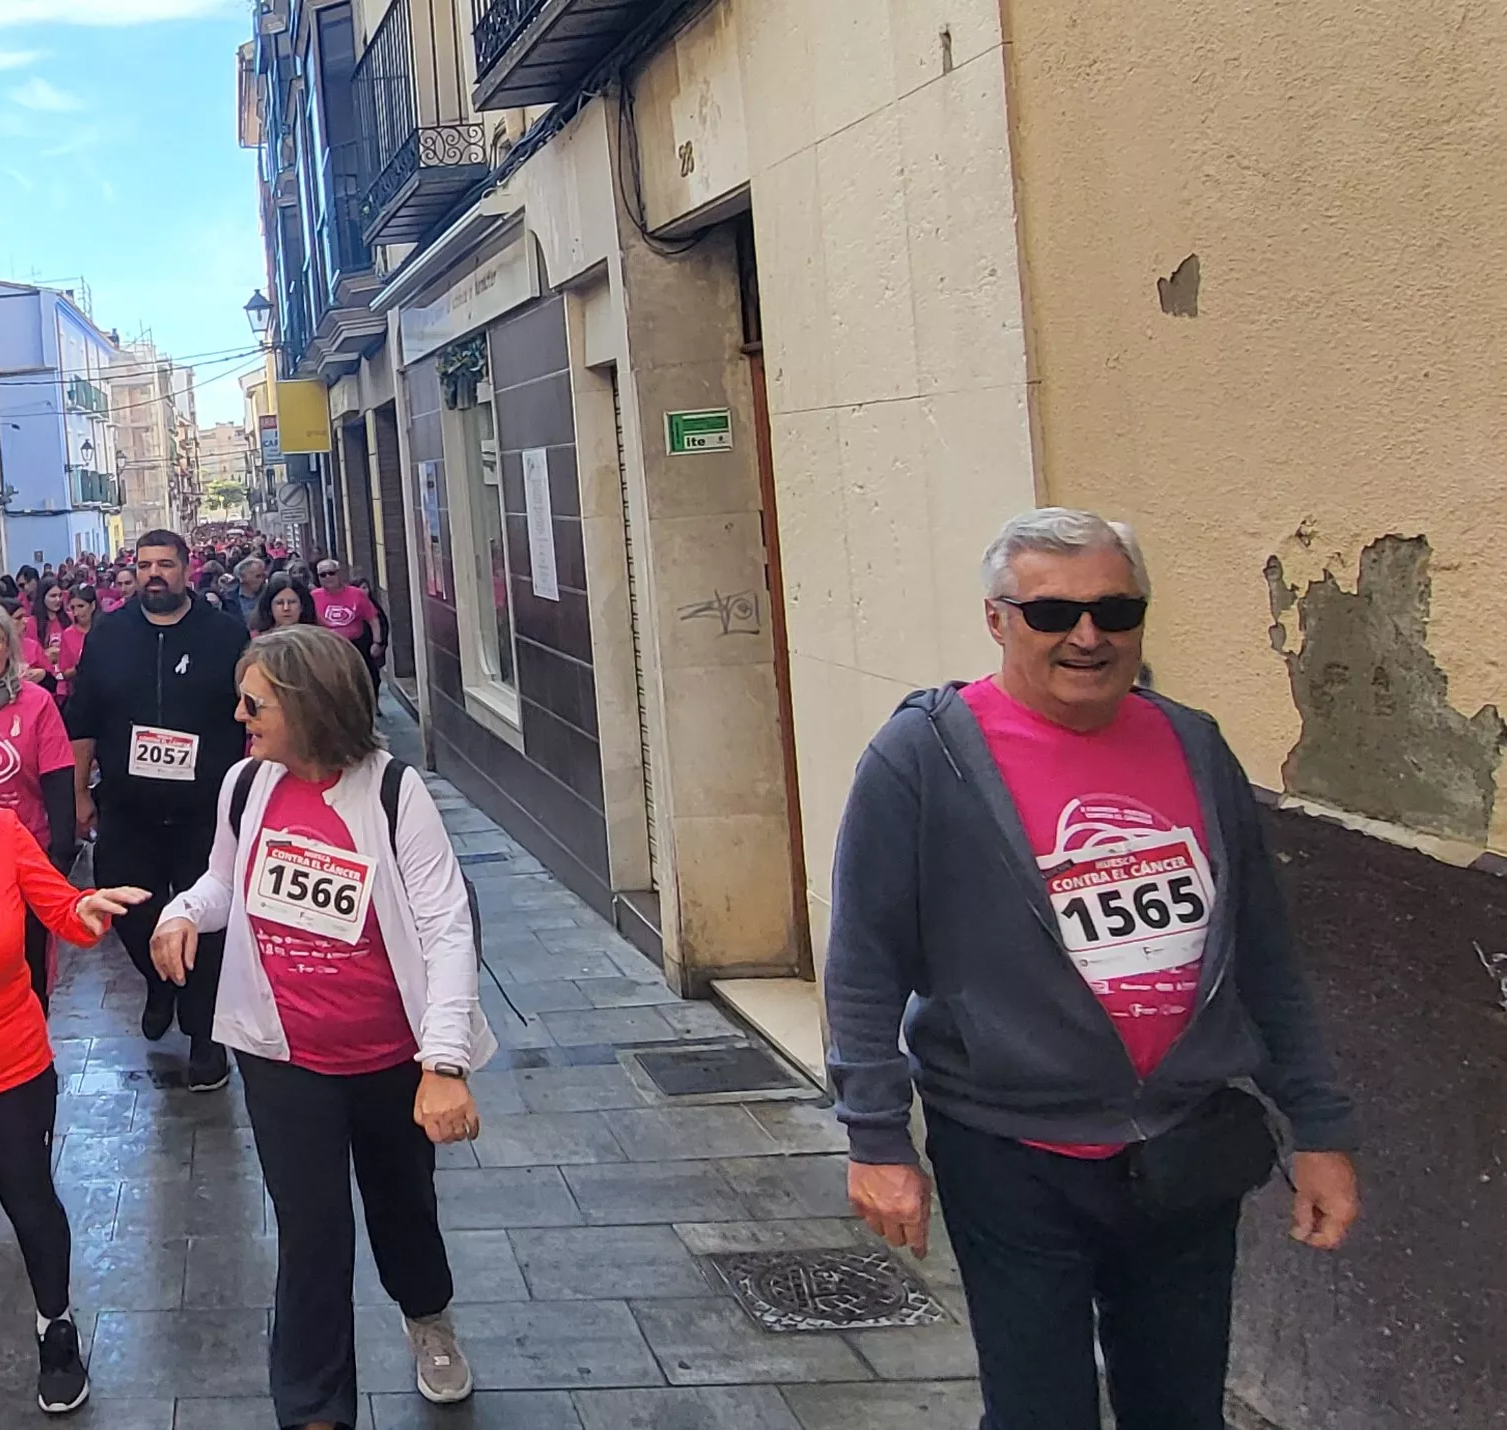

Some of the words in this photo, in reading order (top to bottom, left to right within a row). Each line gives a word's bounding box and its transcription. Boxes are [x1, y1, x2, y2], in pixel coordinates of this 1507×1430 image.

[136, 744, 190, 766] 2057
[271, 848, 309, 867] CONTRA
[311, 859, 322, 870] EL
[323, 861, 361, 880] CÁNCER
[1051, 870, 1111, 892] CONTRA
[1112, 865, 1130, 881] EL
[1131, 856, 1189, 876] CÁNCER
[267, 864, 358, 915] 1566
[1060, 875, 1205, 942] 1565
